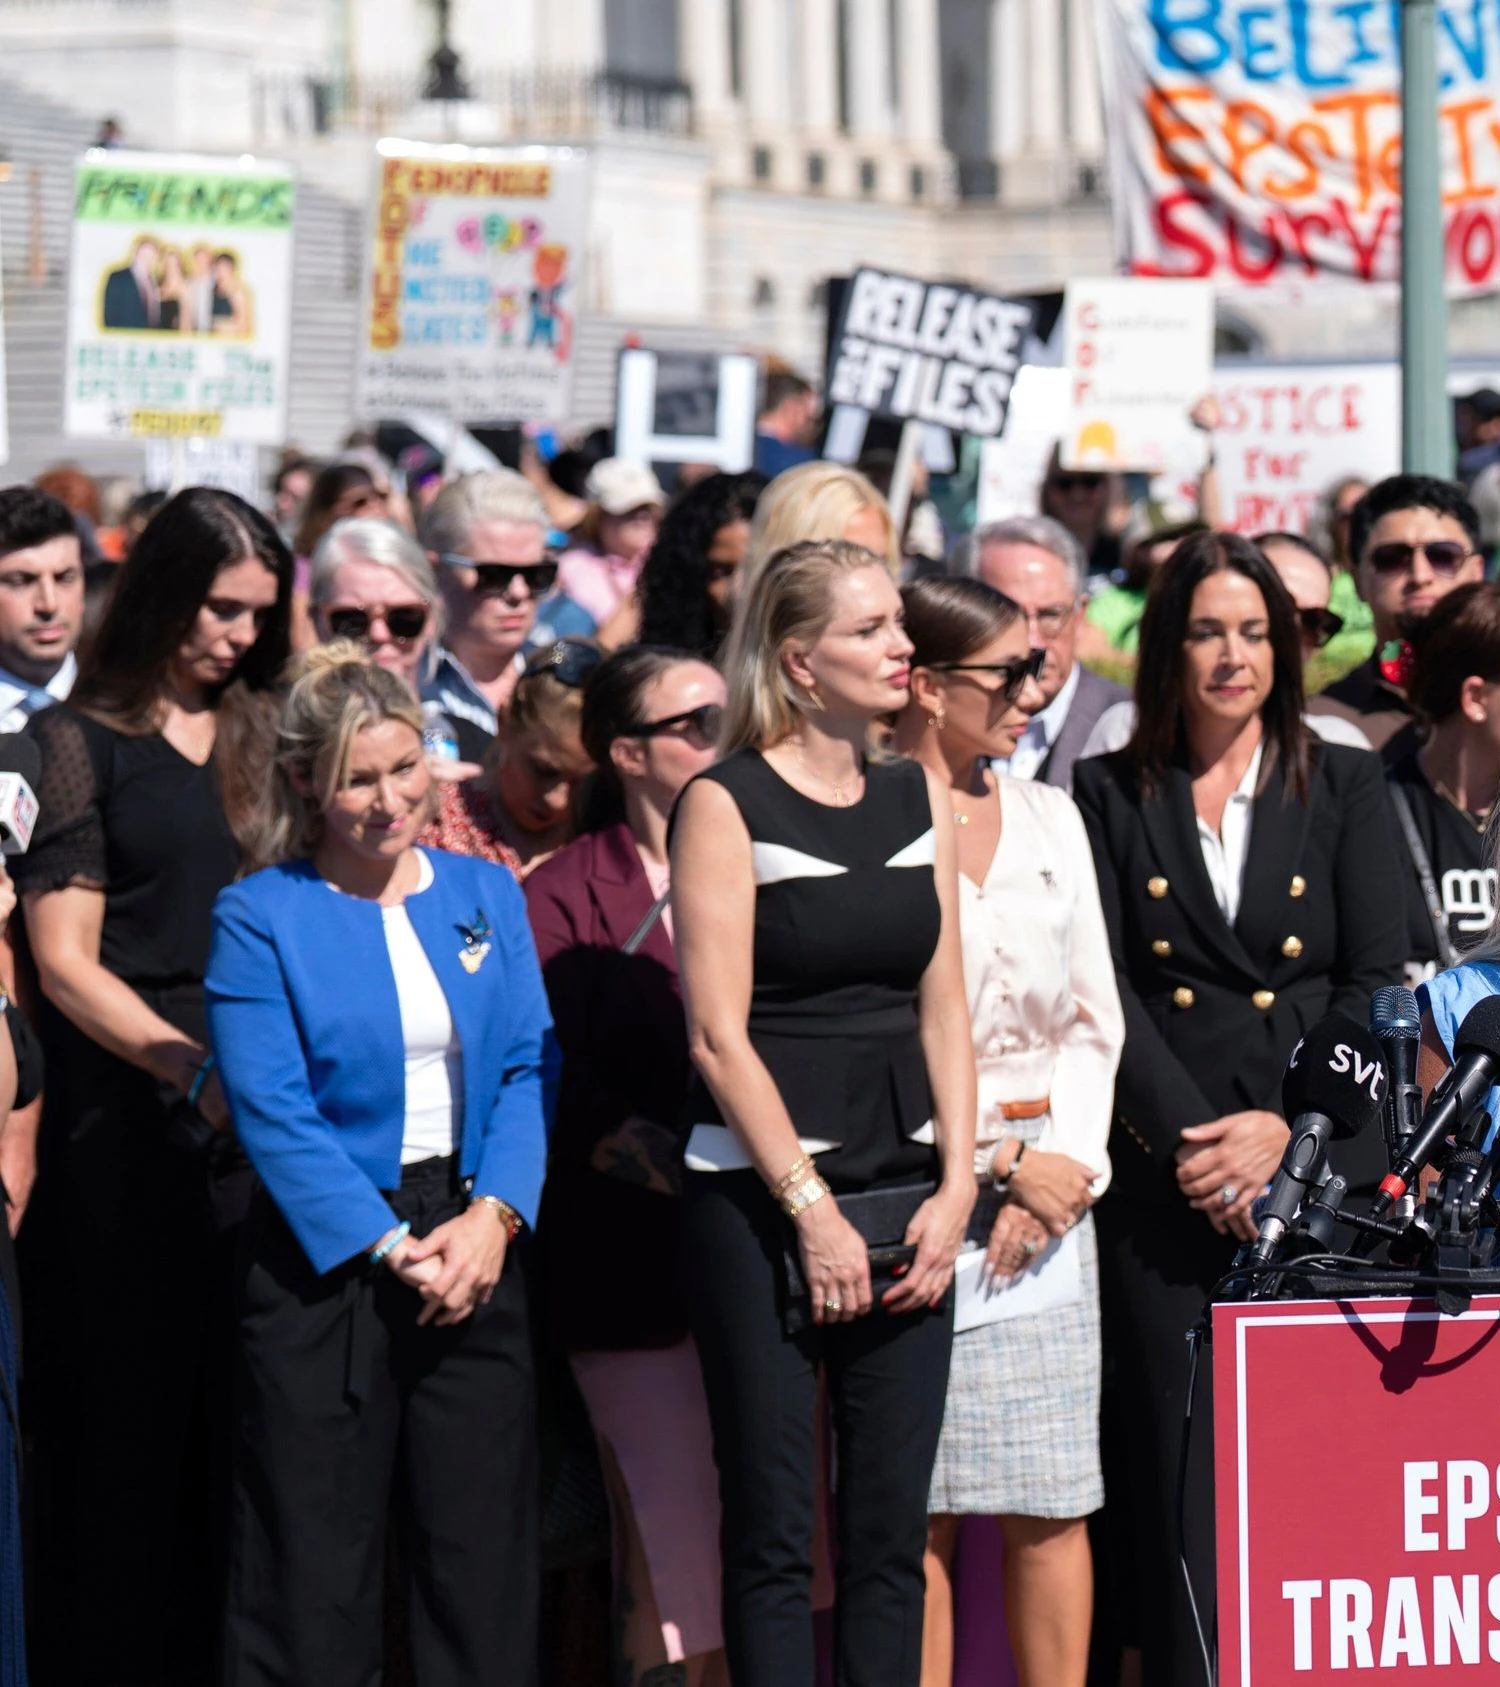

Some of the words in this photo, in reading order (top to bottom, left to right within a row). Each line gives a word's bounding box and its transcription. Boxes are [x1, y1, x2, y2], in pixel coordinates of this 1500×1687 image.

[845, 268, 1033, 376] RELEASE
[858, 343, 1014, 437] FILES
[1216, 383, 1364, 437] STICE
[1329, 1044, 1384, 1101] svt
